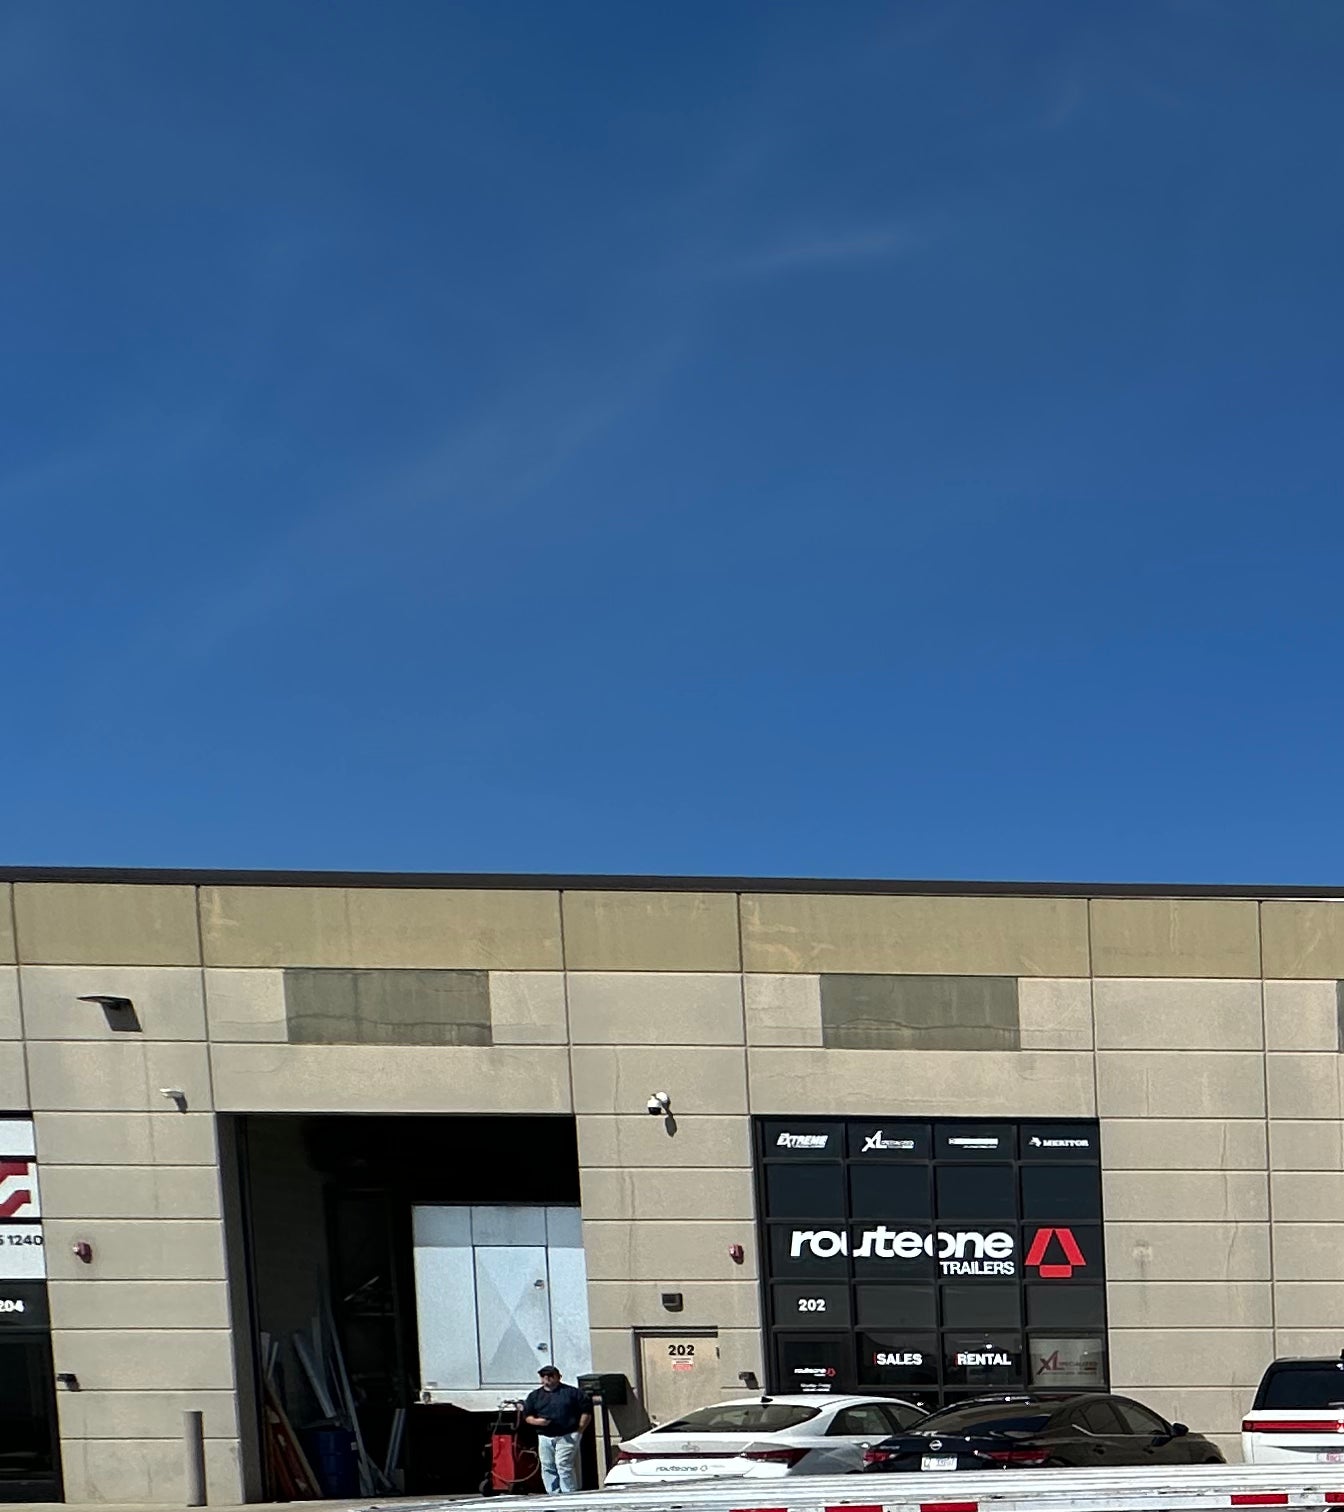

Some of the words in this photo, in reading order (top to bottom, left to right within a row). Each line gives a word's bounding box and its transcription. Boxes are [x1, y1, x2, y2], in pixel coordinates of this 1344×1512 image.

[1042, 1139, 1089, 1147] MERITOR
[7, 1234, 44, 1246] 1240
[790, 1226, 1014, 1259] routeone
[939, 1261, 1015, 1275] TRAILERS
[798, 1299, 826, 1311] 202
[668, 1345, 695, 1356] 202
[876, 1353, 923, 1366] SALES
[957, 1353, 1012, 1366] RENTAL
